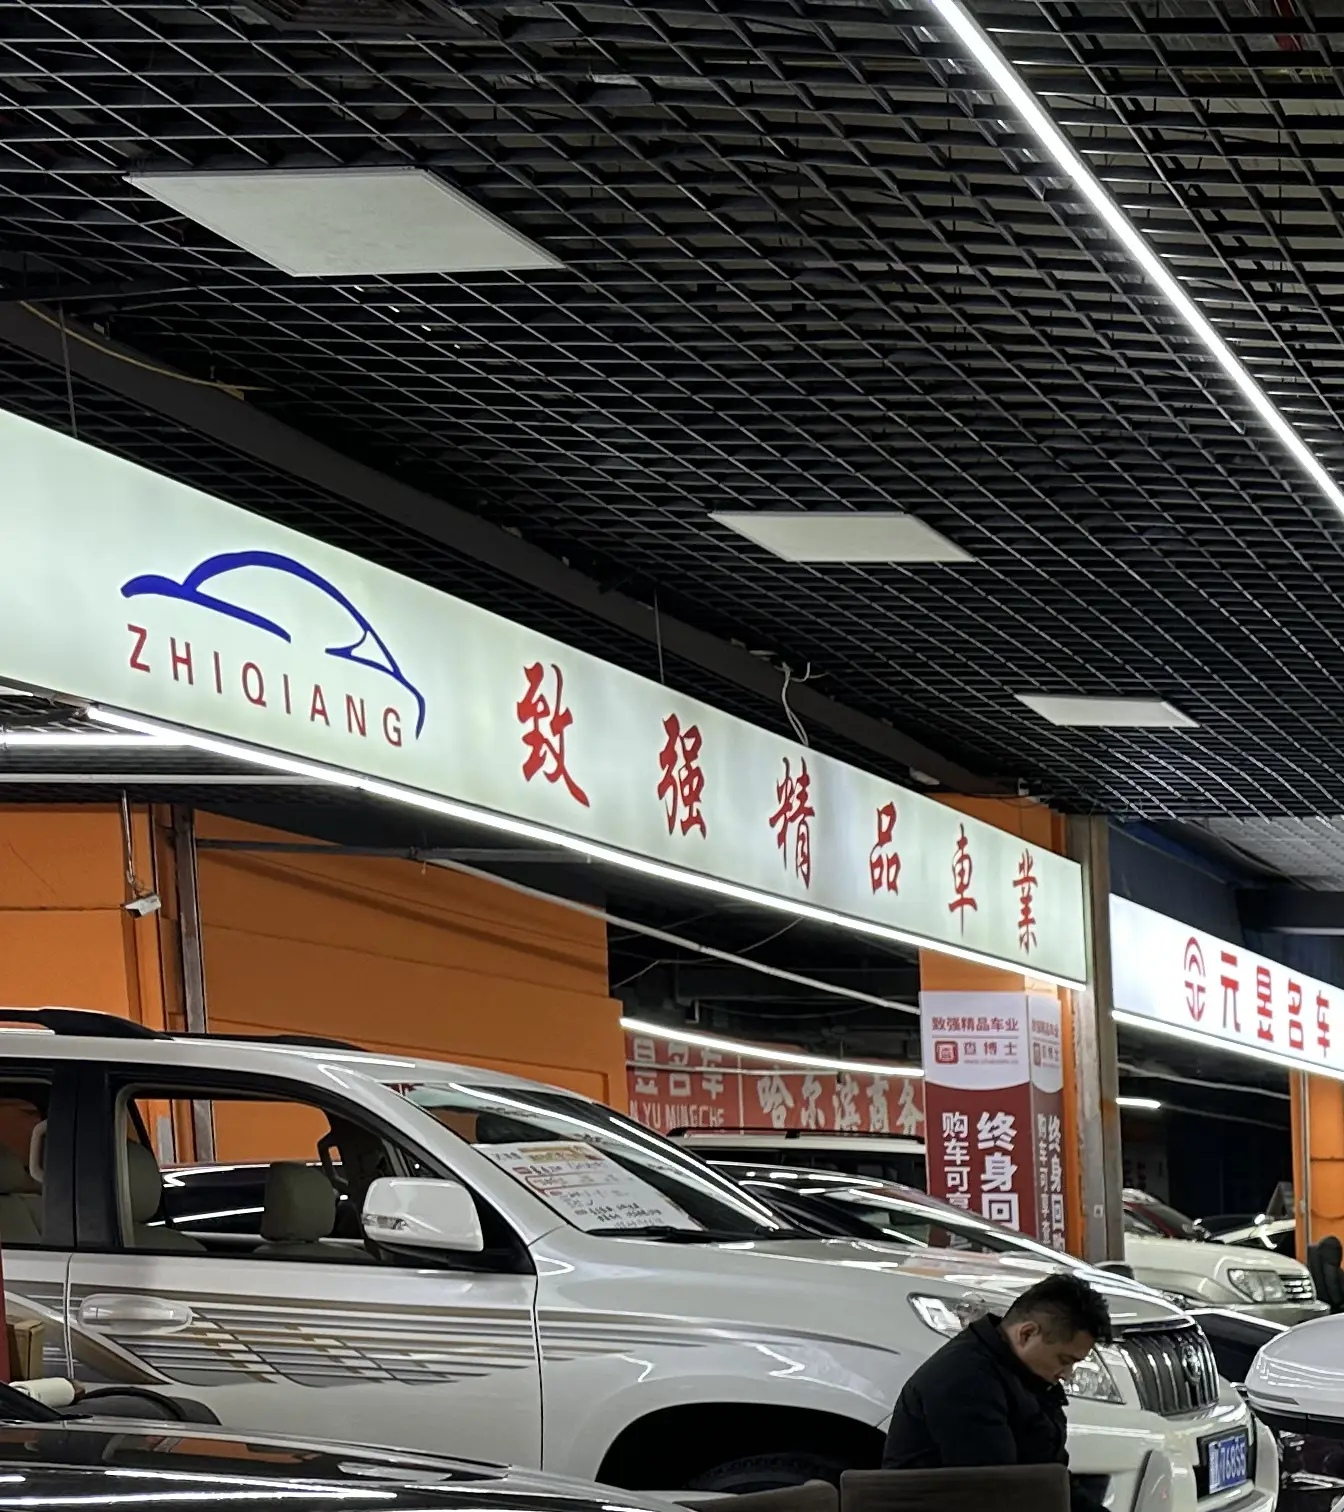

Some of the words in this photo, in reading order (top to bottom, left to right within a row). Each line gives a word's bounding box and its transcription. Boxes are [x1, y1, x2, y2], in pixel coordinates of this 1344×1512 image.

[126, 621, 404, 749] ZHIQIANG
[514, 660, 1040, 954] 致强精品車業
